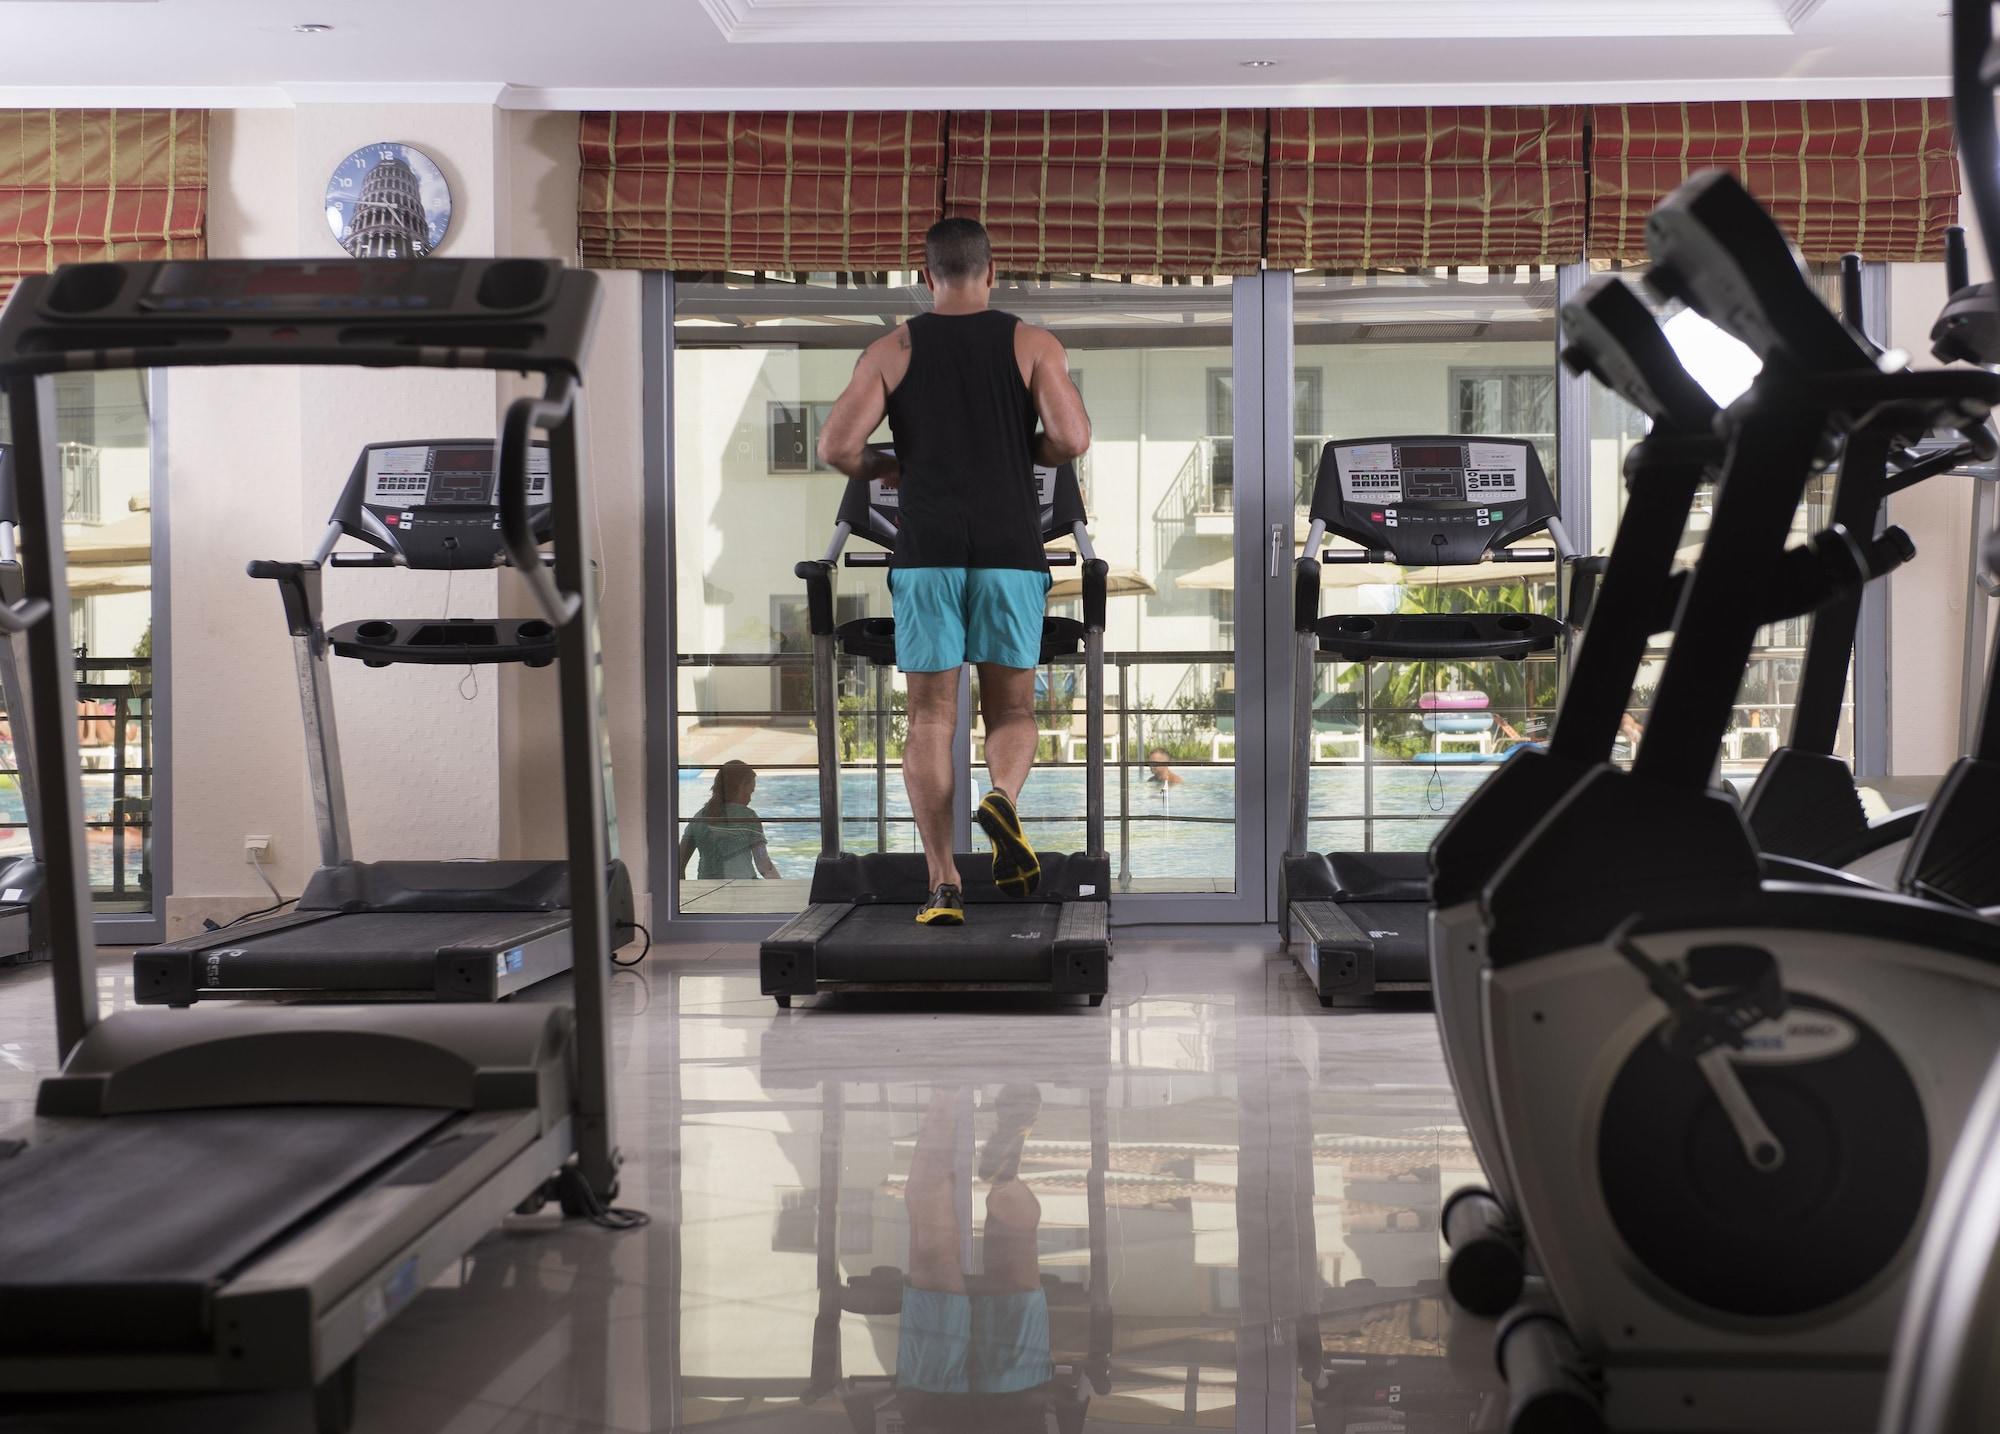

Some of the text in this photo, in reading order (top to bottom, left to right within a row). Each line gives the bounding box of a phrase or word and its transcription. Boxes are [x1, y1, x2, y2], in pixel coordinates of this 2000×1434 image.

[379, 151, 393, 160] 12
[355, 159, 366, 168] 11
[340, 178, 352, 187] 10
[335, 202, 343, 211] 9
[428, 222, 436, 231] 4
[412, 241, 421, 251] 5
[387, 249, 397, 258] 6
